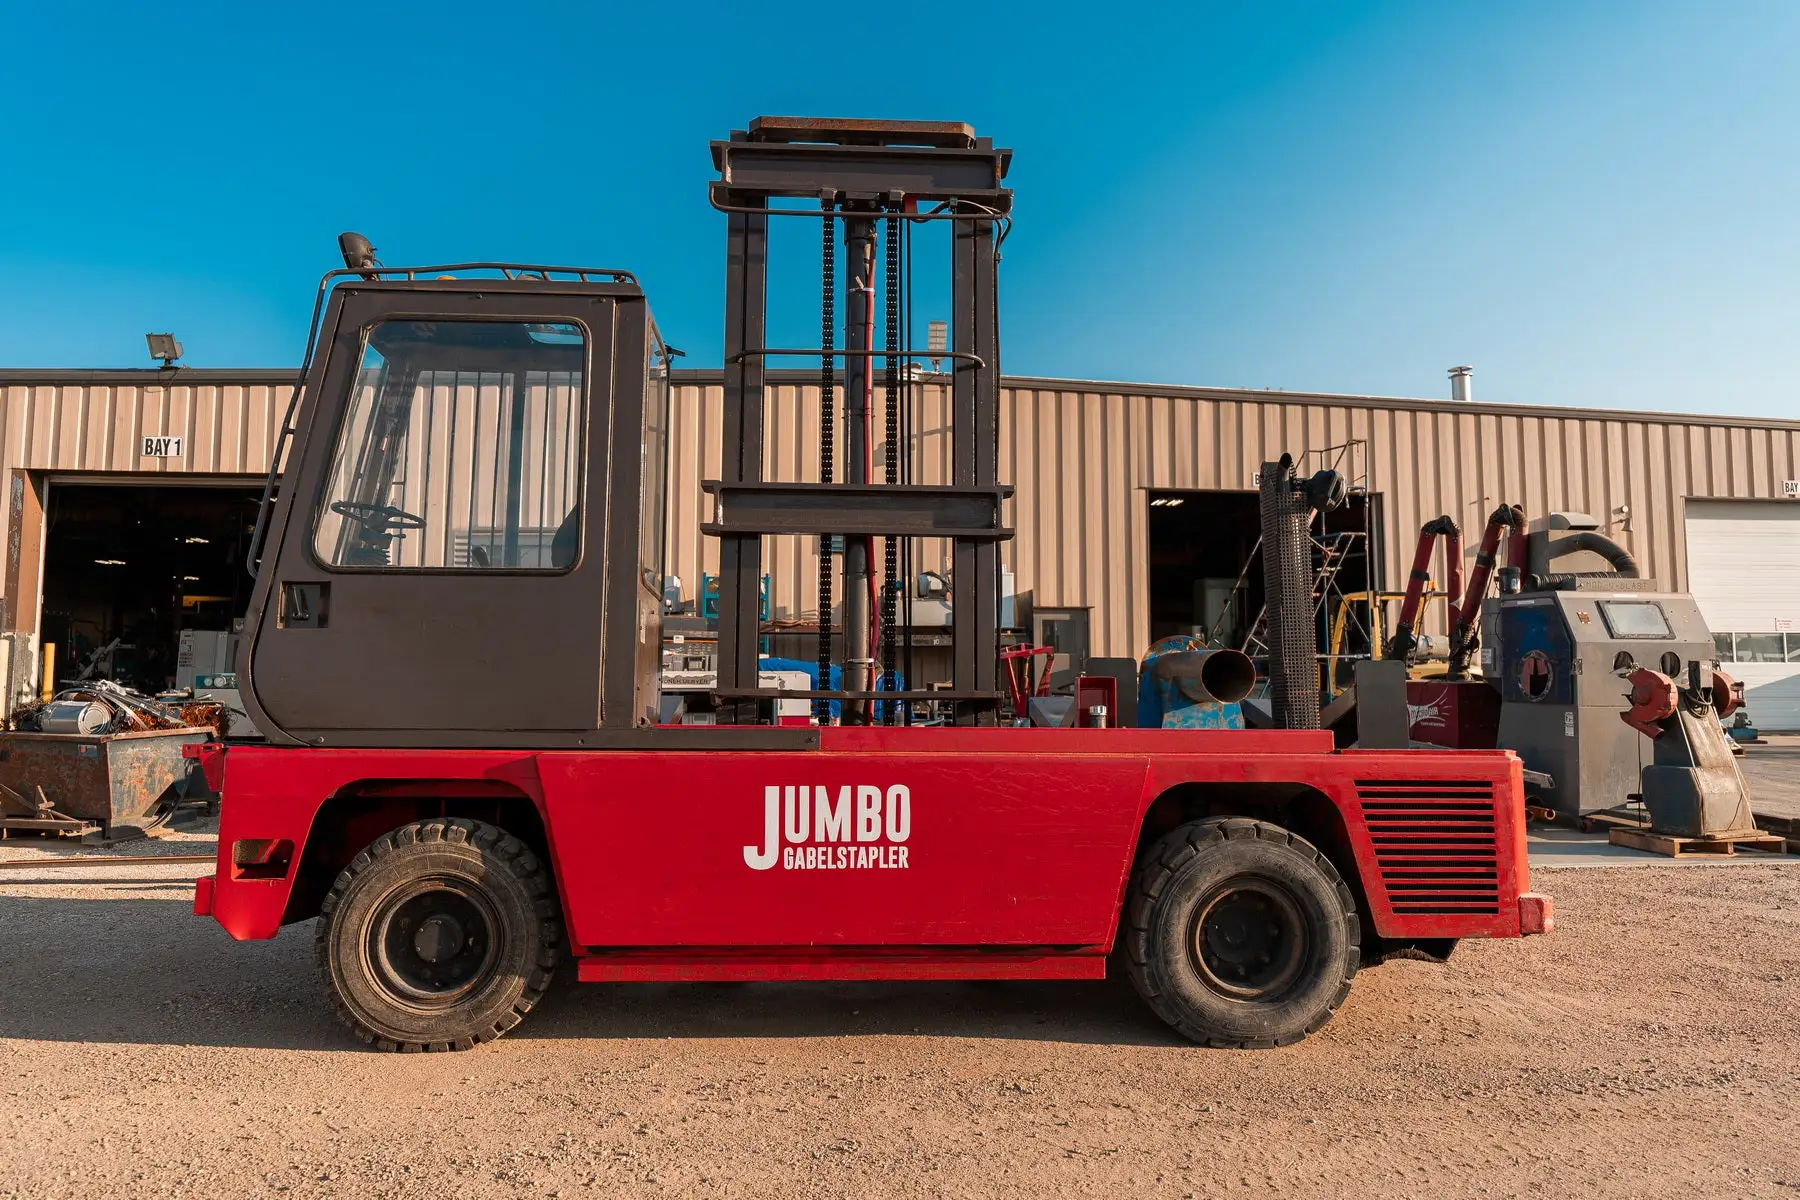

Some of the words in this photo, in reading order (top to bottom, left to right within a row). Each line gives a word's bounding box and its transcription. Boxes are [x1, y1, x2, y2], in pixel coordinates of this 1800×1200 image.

[144, 438, 171, 456] BAY
[174, 438, 181, 456] 1
[1784, 482, 1799, 493] BAY
[743, 784, 911, 871] JUMBO
[783, 846, 909, 870] GABELSTAPLER
